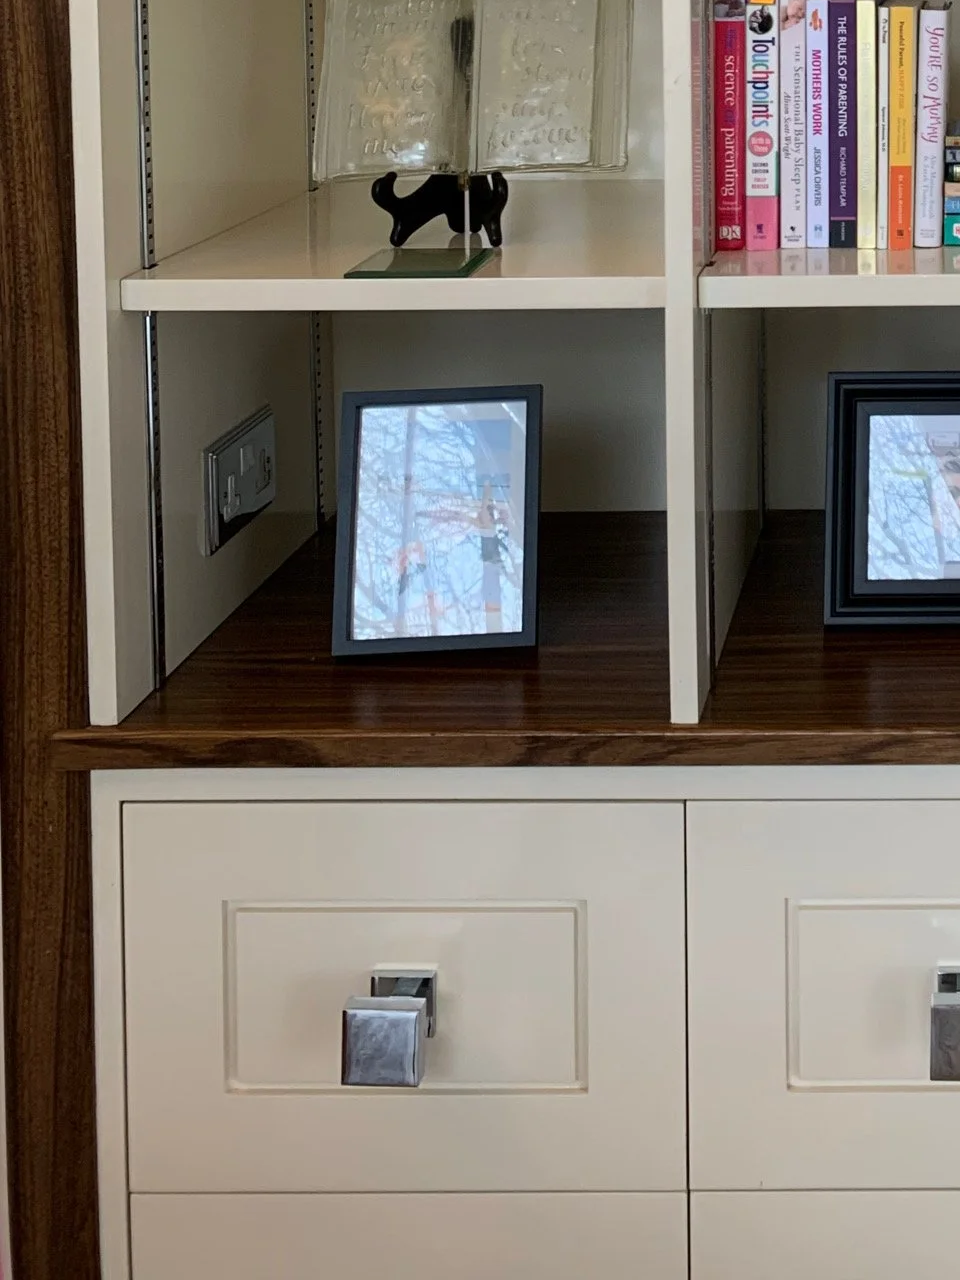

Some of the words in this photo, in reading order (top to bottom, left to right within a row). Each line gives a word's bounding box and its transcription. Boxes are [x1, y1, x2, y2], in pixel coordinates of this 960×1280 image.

[837, 16, 847, 34] THE
[837, 36, 847, 66] RULES
[725, 55, 739, 106] science
[747, 36, 775, 128] Touchpoints
[812, 49, 822, 100] MOTHERS
[838, 67, 847, 81] OF
[784, 92, 792, 115] Alison
[793, 66, 803, 125] Sensational
[838, 83, 848, 137] PARENTING
[812, 102, 823, 136] WORK
[791, 129, 804, 154] Baby
[720, 127, 739, 197] parenting
[791, 157, 804, 185] Sleep
[813, 146, 822, 174] JESSICA
[839, 146, 847, 176] RICHARD
[813, 176, 822, 206] CHIVERS
[839, 178, 848, 207] TEMPLAR
[720, 226, 741, 239] DK
